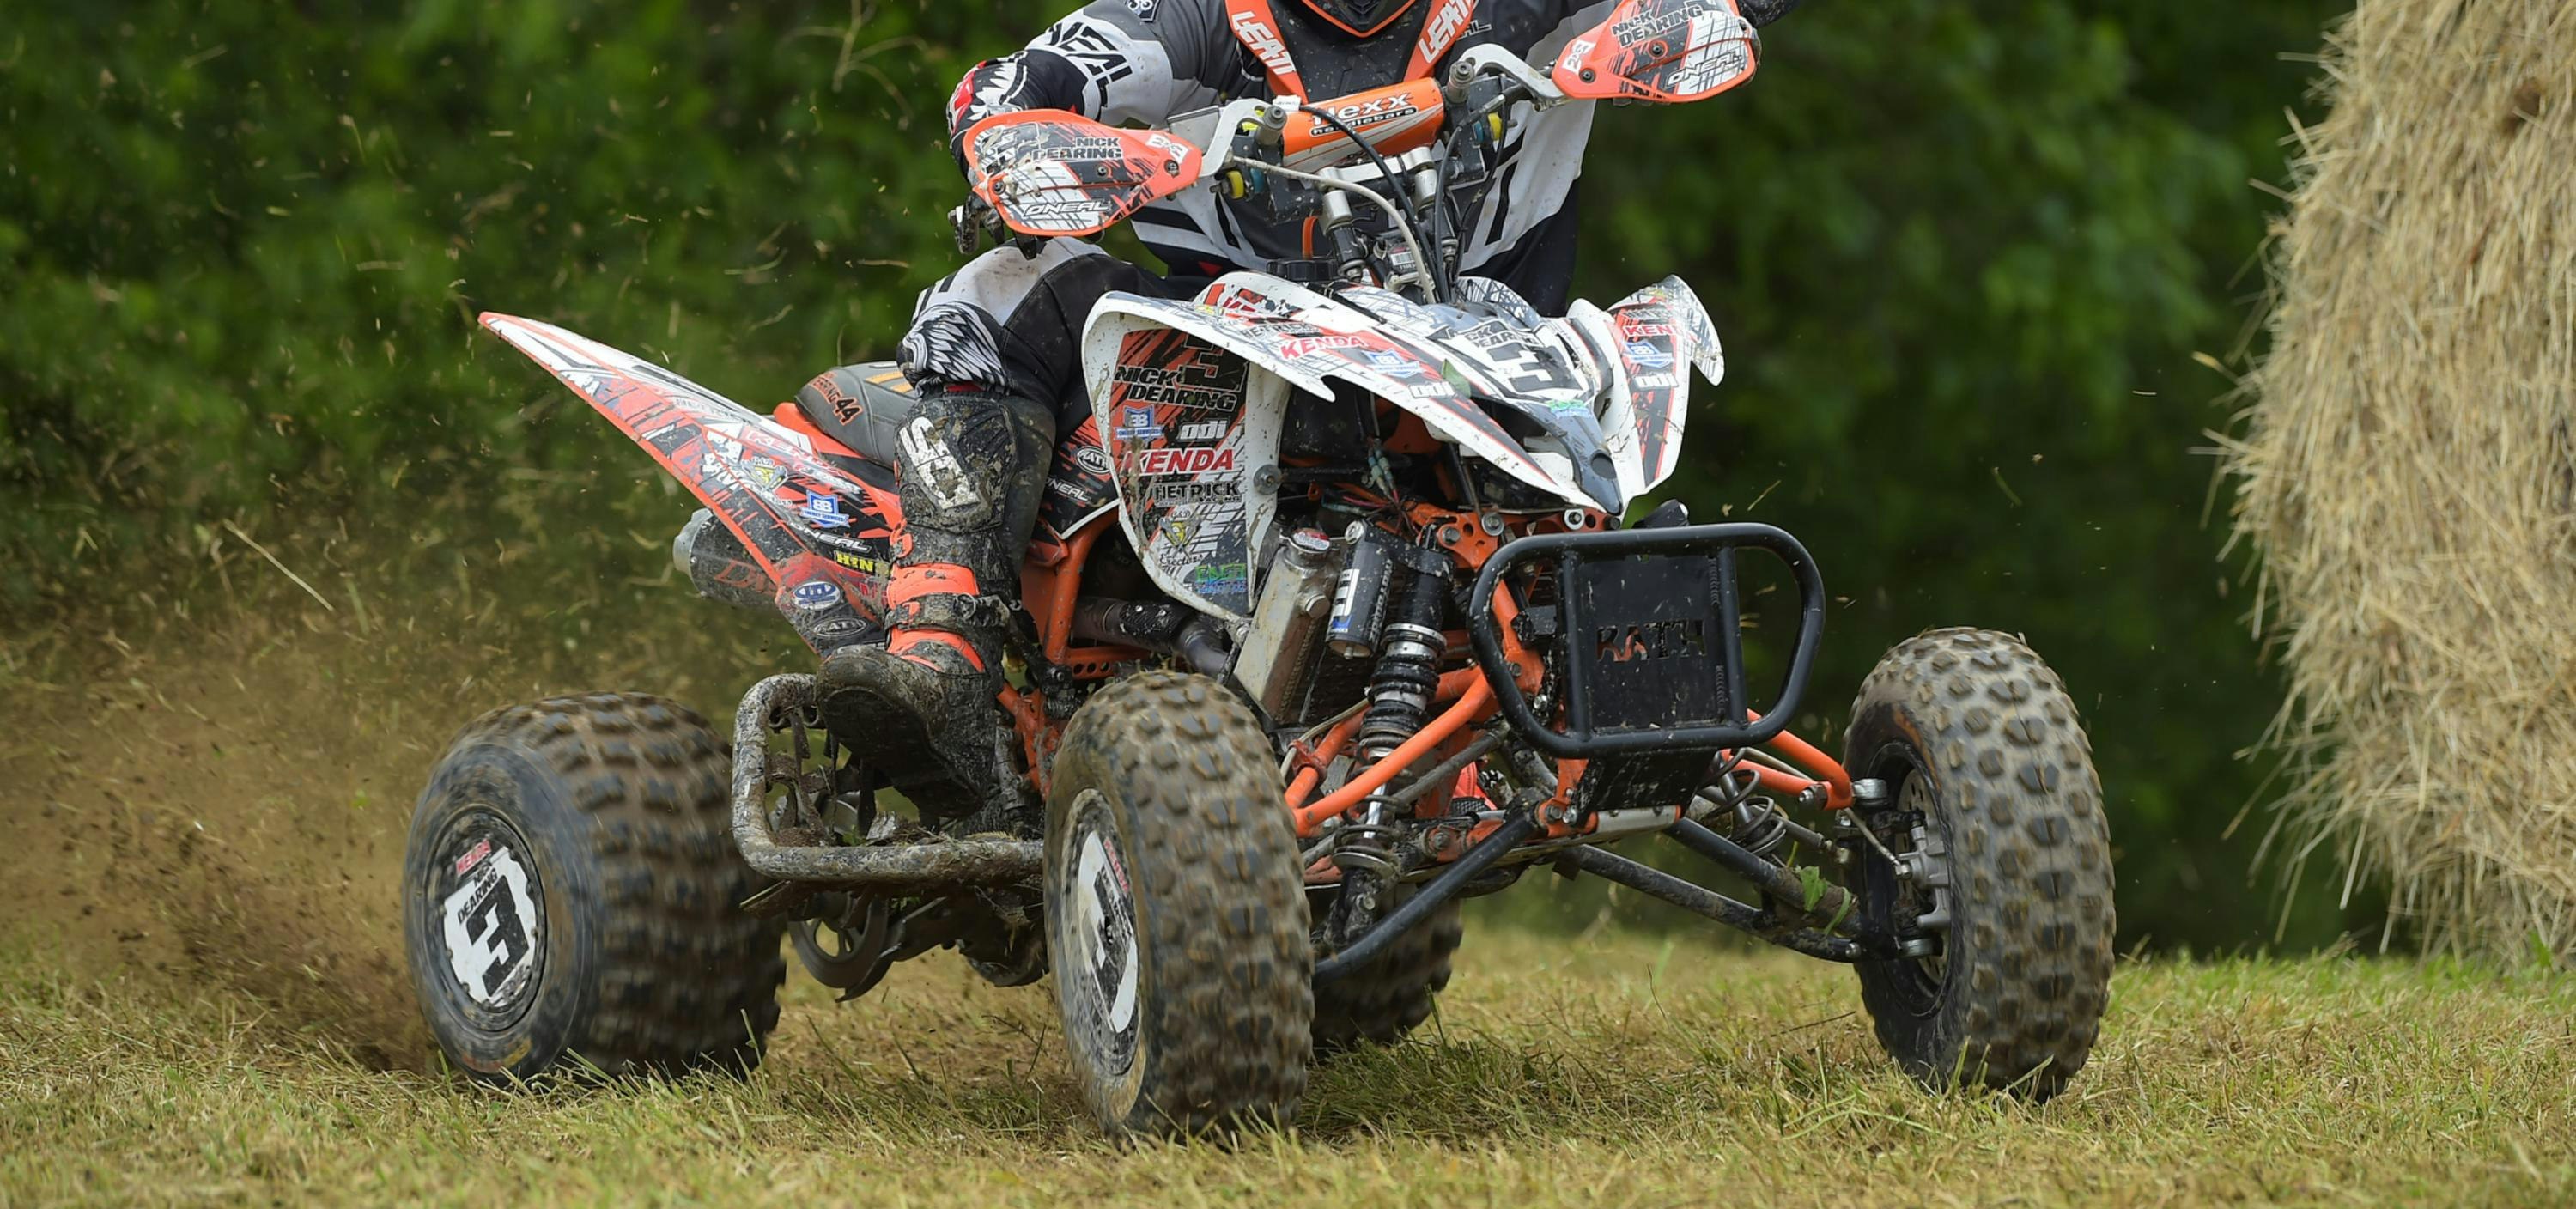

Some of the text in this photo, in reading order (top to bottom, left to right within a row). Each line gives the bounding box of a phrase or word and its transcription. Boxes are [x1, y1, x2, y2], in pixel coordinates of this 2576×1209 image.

[1418, 0, 1473, 64] LEAT
[1613, 12, 1652, 35] NICK
[1312, 107, 1415, 135] hadlebars
[1075, 137, 1121, 147] NICK
[1115, 366, 1180, 386] NICK
[1486, 342, 1584, 392] 3
[835, 398, 862, 425] 44
[1127, 384, 1237, 412] DEARING
[1122, 449, 1235, 474] KENDA
[1048, 477, 1091, 501] NEAL
[835, 550, 884, 574] HIN
[1596, 620, 1706, 662] RATH
[465, 875, 529, 997] 3
